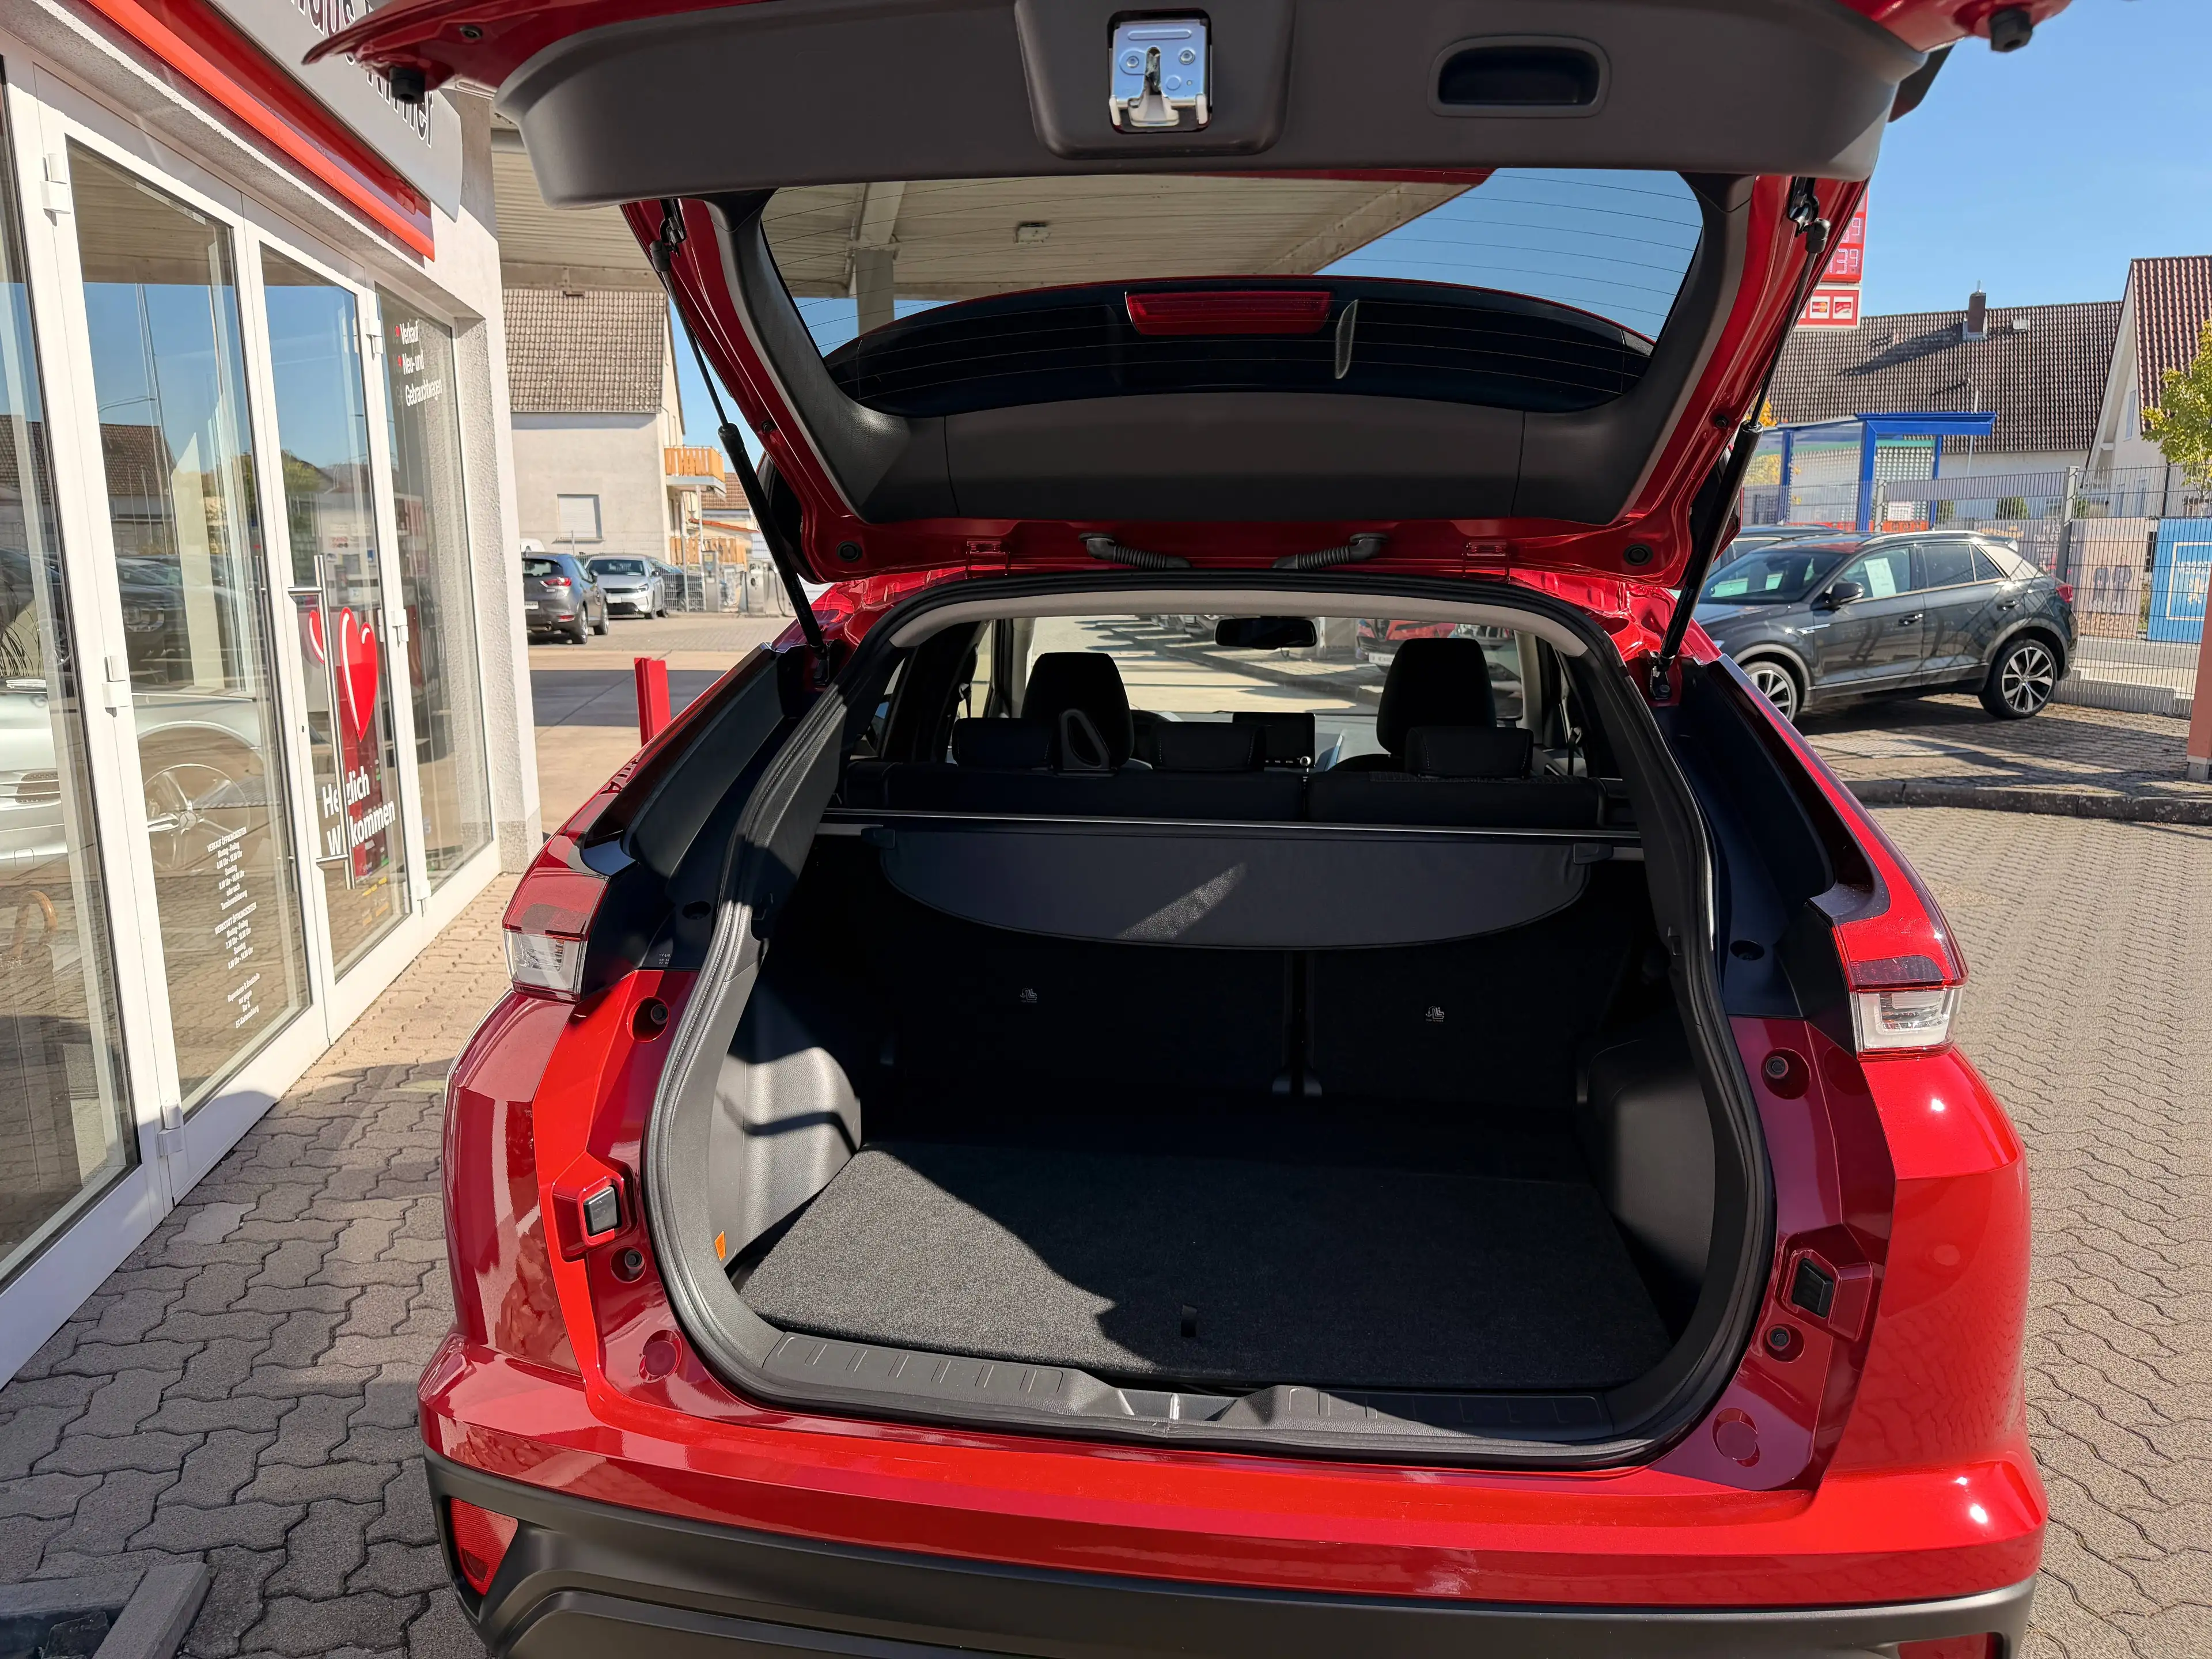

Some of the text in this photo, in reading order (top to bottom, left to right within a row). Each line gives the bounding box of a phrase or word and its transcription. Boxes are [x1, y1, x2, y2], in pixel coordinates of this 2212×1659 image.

[400, 320, 420, 345] Verkauf
[402, 348, 424, 376] Neu- und
[405, 378, 443, 407] Gebrauchtwagen
[323, 766, 370, 819] Hezlich
[327, 801, 396, 856] Wkommen
